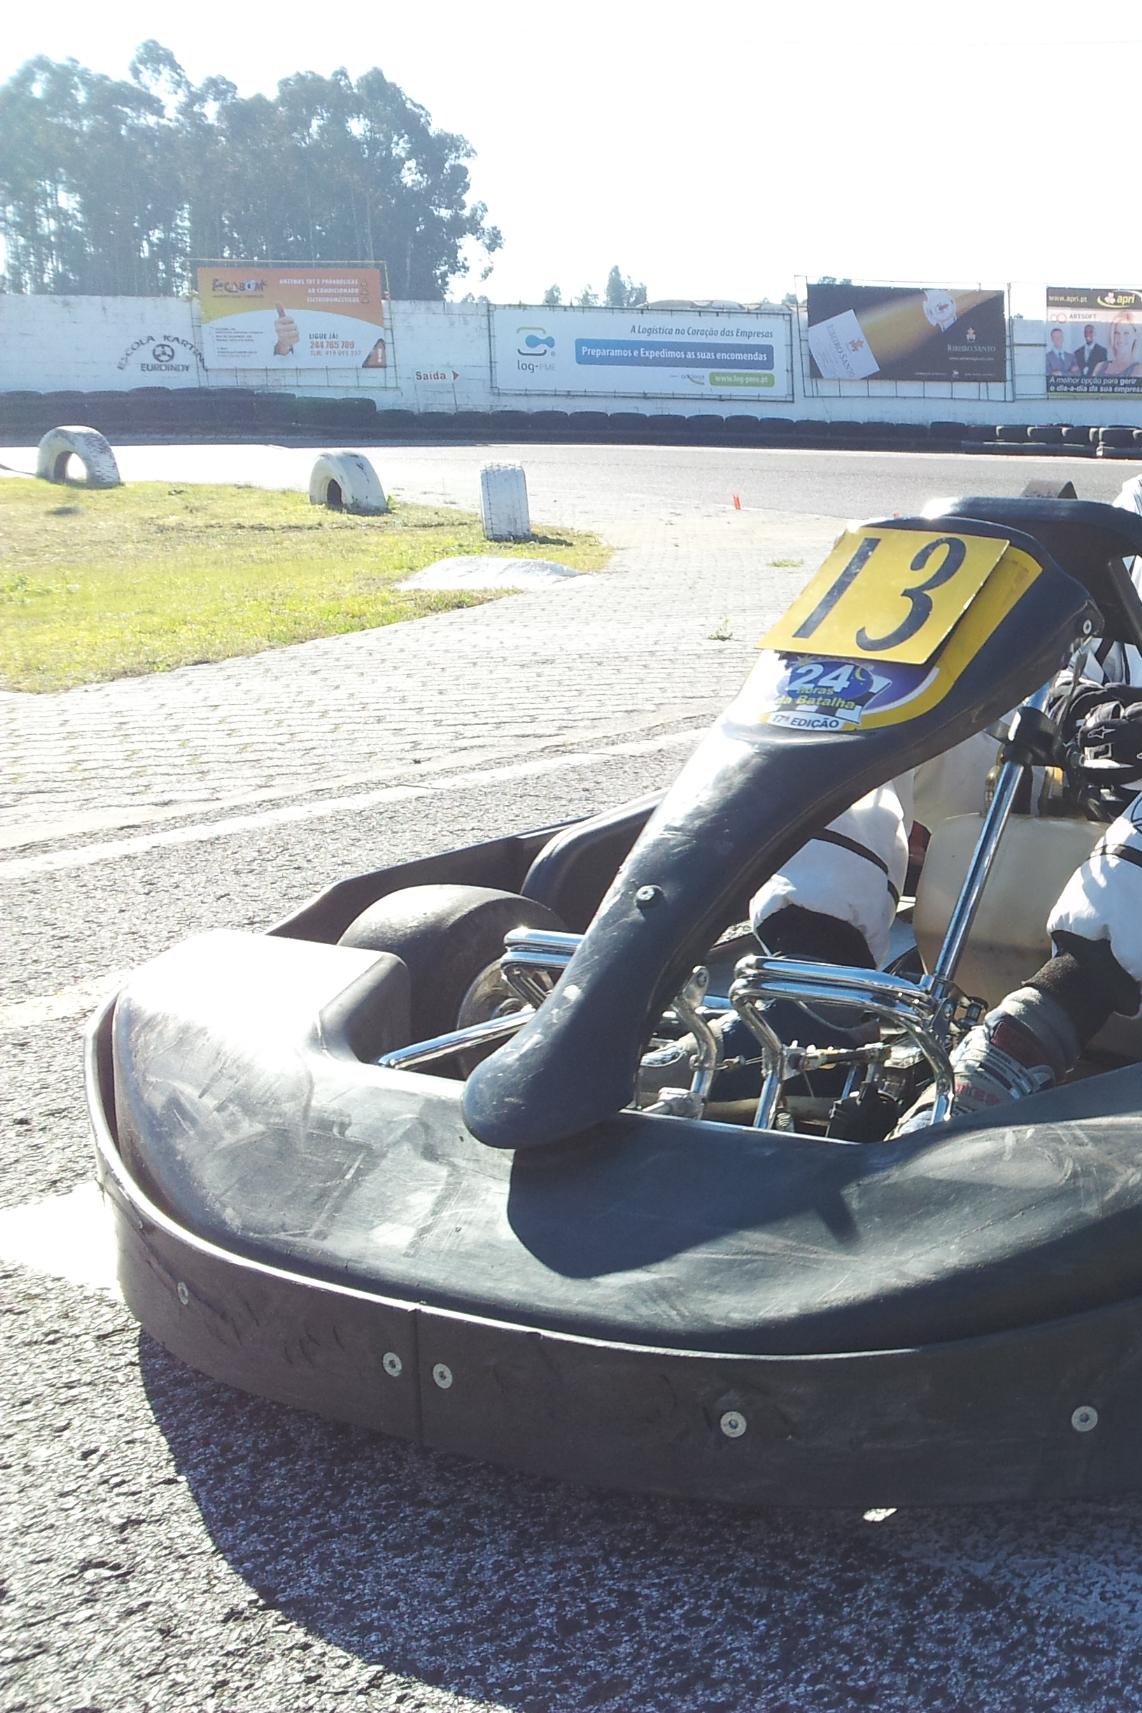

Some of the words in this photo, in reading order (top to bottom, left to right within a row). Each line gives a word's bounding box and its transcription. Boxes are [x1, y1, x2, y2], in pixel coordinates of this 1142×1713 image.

[1117, 295, 1136, 304] apri
[631, 325, 636, 334] A
[687, 327, 719, 338] Coração
[720, 328, 734, 337] das
[735, 329, 773, 340] Empresas
[117, 335, 156, 371] ESCOLA
[582, 346, 632, 358] Preparamos
[633, 349, 639, 357] e
[640, 347, 685, 359] Expedimos
[697, 352, 715, 360] suas
[716, 351, 767, 361] encomendas
[792, 537, 967, 651] 13
[785, 663, 855, 693] 24
[797, 695, 856, 710] Batalha
[791, 717, 839, 729] EDIÇÃO
